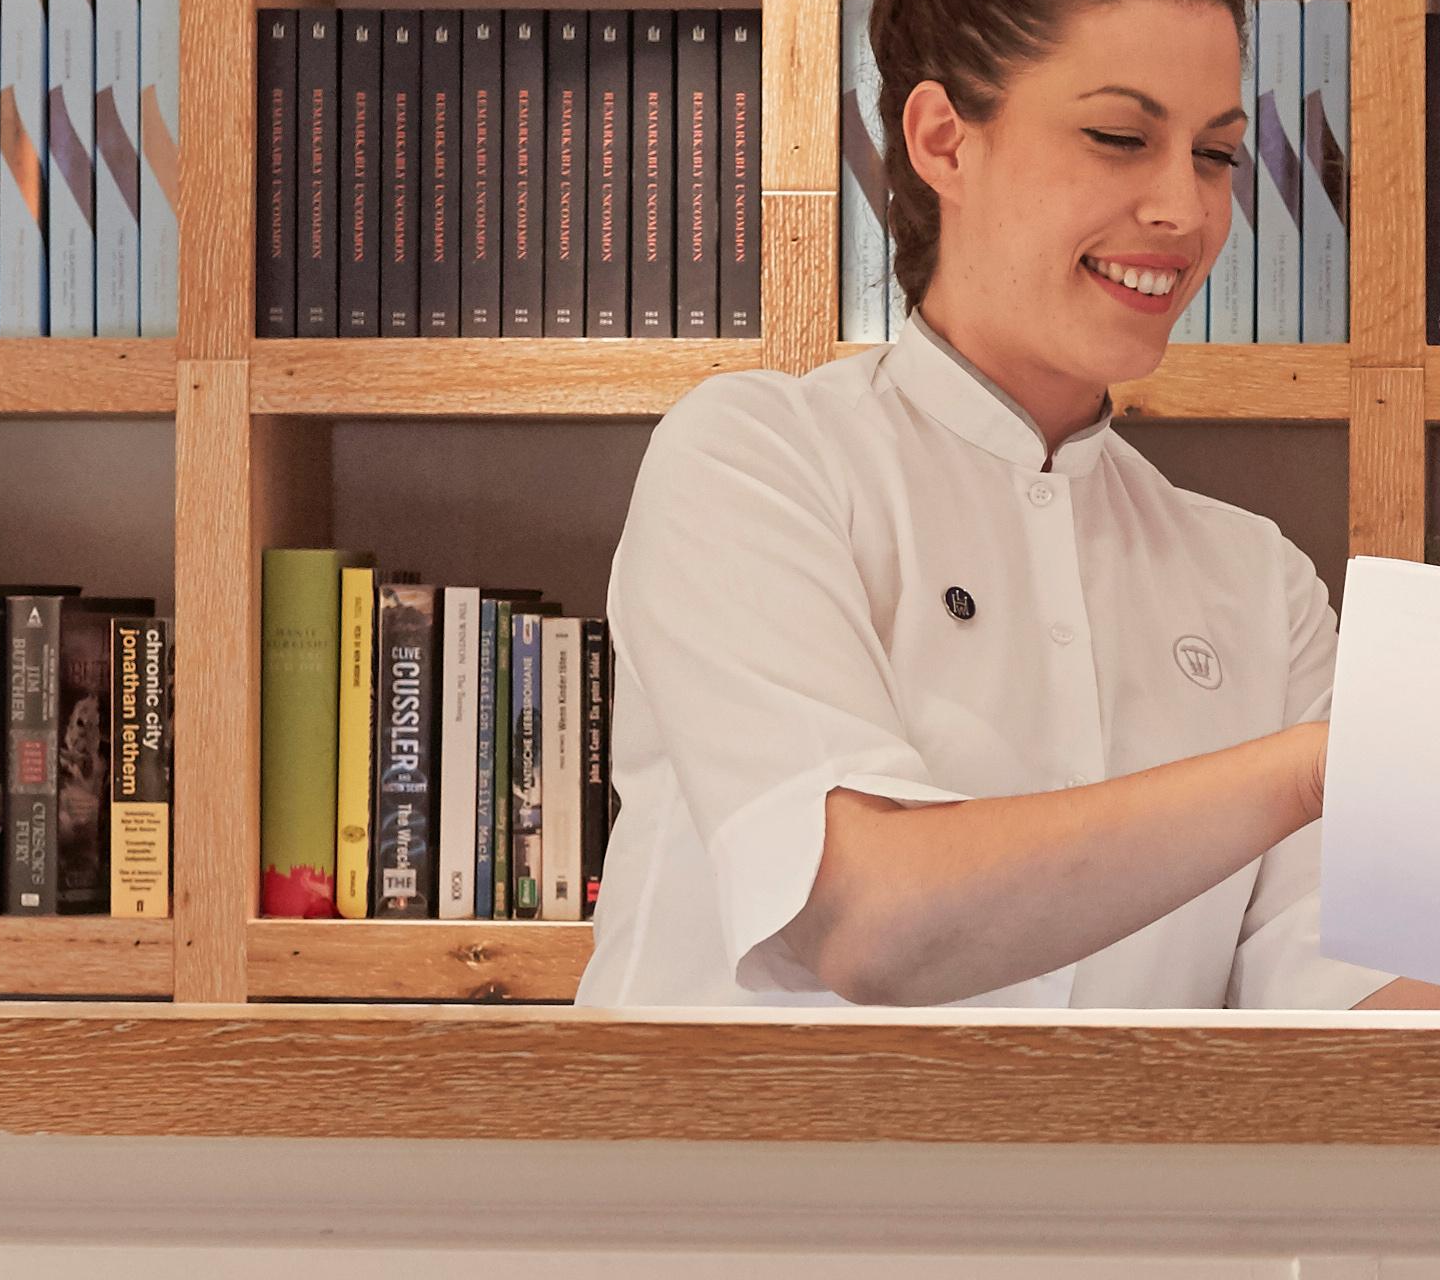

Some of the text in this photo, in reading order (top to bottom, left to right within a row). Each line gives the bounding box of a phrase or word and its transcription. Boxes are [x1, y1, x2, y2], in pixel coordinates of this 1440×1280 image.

[11, 637, 26, 722] BUTCHER
[26, 664, 41, 694] JIM
[146, 628, 165, 751] chronic city
[391, 646, 422, 660] CLIVE
[121, 627, 141, 796] jonathan lethem
[391, 661, 420, 771] CUSSLER
[477, 629, 493, 863] Inspiration by Emily Mack
[15, 819, 31, 865] FURY
[397, 803, 412, 826] The
